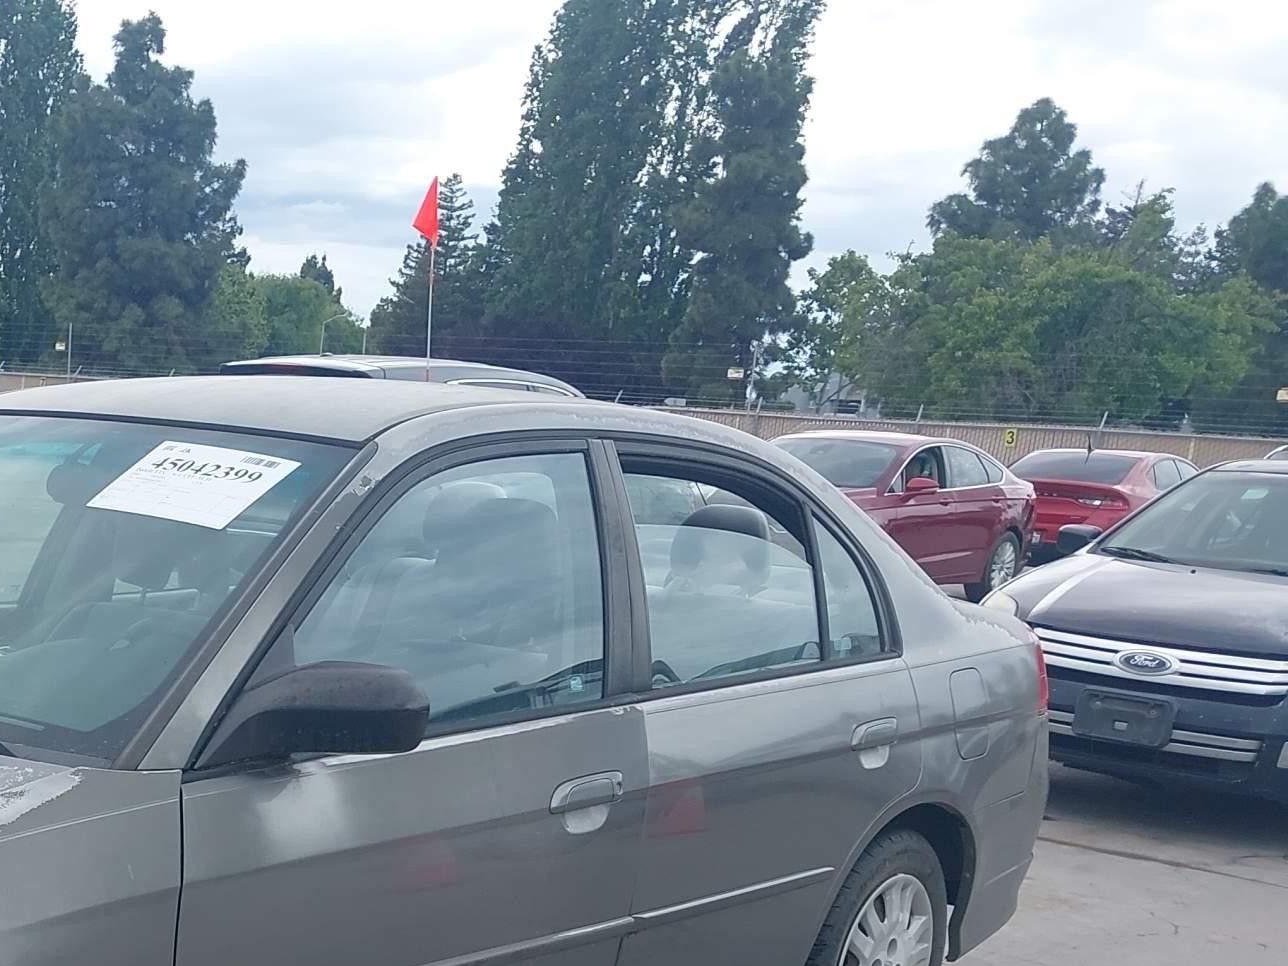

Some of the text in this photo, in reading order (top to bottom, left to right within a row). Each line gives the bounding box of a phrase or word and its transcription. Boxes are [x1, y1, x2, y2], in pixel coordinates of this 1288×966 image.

[1006, 430, 1015, 445] 3
[151, 456, 263, 484] 45042399
[1129, 655, 1161, 668] Ford
